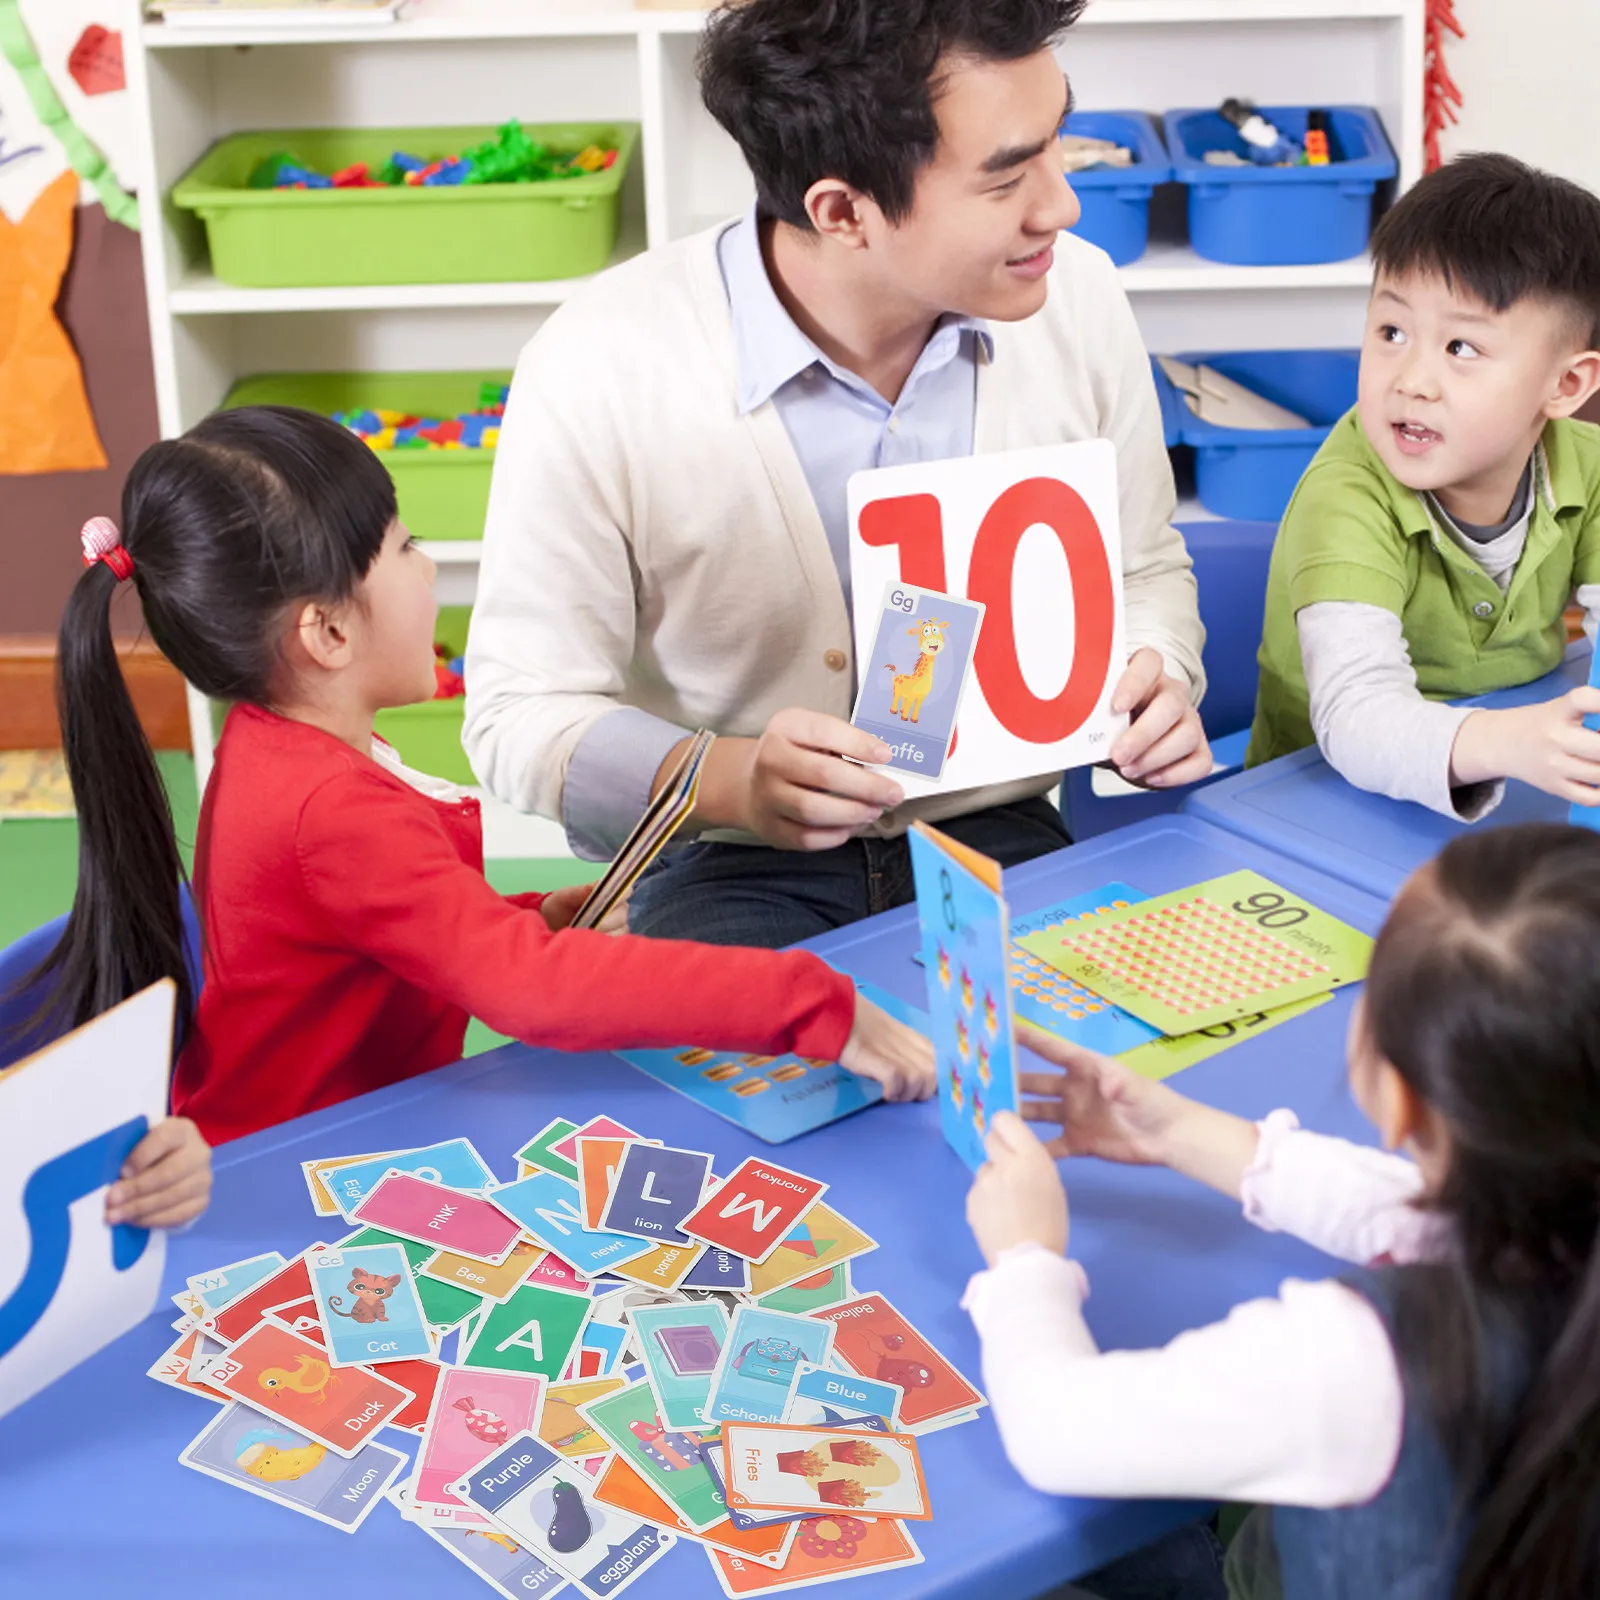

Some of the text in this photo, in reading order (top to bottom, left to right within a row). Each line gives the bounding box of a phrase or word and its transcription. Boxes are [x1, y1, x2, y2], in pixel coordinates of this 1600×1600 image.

[890, 590, 915, 612] Gg
[858, 476, 1115, 759] 10
[1232, 892, 1309, 928] 90
[343, 1178, 365, 1202] Eigh
[641, 1171, 671, 1204] L
[752, 1168, 807, 1194] monkey
[428, 1203, 458, 1231] PINK
[534, 1199, 582, 1236] N
[719, 1192, 781, 1232] M
[634, 1217, 662, 1231] lion
[590, 1240, 626, 1259] newt
[318, 1255, 341, 1267] Cc
[538, 1264, 566, 1278] ive
[654, 1249, 680, 1277] panda
[197, 1277, 221, 1289] Yy
[456, 1266, 487, 1285] Bee
[184, 1295, 198, 1306] X
[366, 1340, 398, 1353] Cat
[495, 1320, 543, 1361] A
[160, 1359, 185, 1376] Vv
[211, 1362, 238, 1381] Dd
[826, 1381, 867, 1401] Blue
[344, 1400, 384, 1432] Duck
[480, 1453, 533, 1492] Purple
[744, 1449, 760, 1481] Fries
[342, 1467, 378, 1502] Moon
[733, 1496, 745, 1504] 3
[434, 1508, 451, 1517] E
[739, 1517, 751, 1526] 2
[599, 1534, 656, 1584] eggplant
[728, 1554, 746, 1572] er
